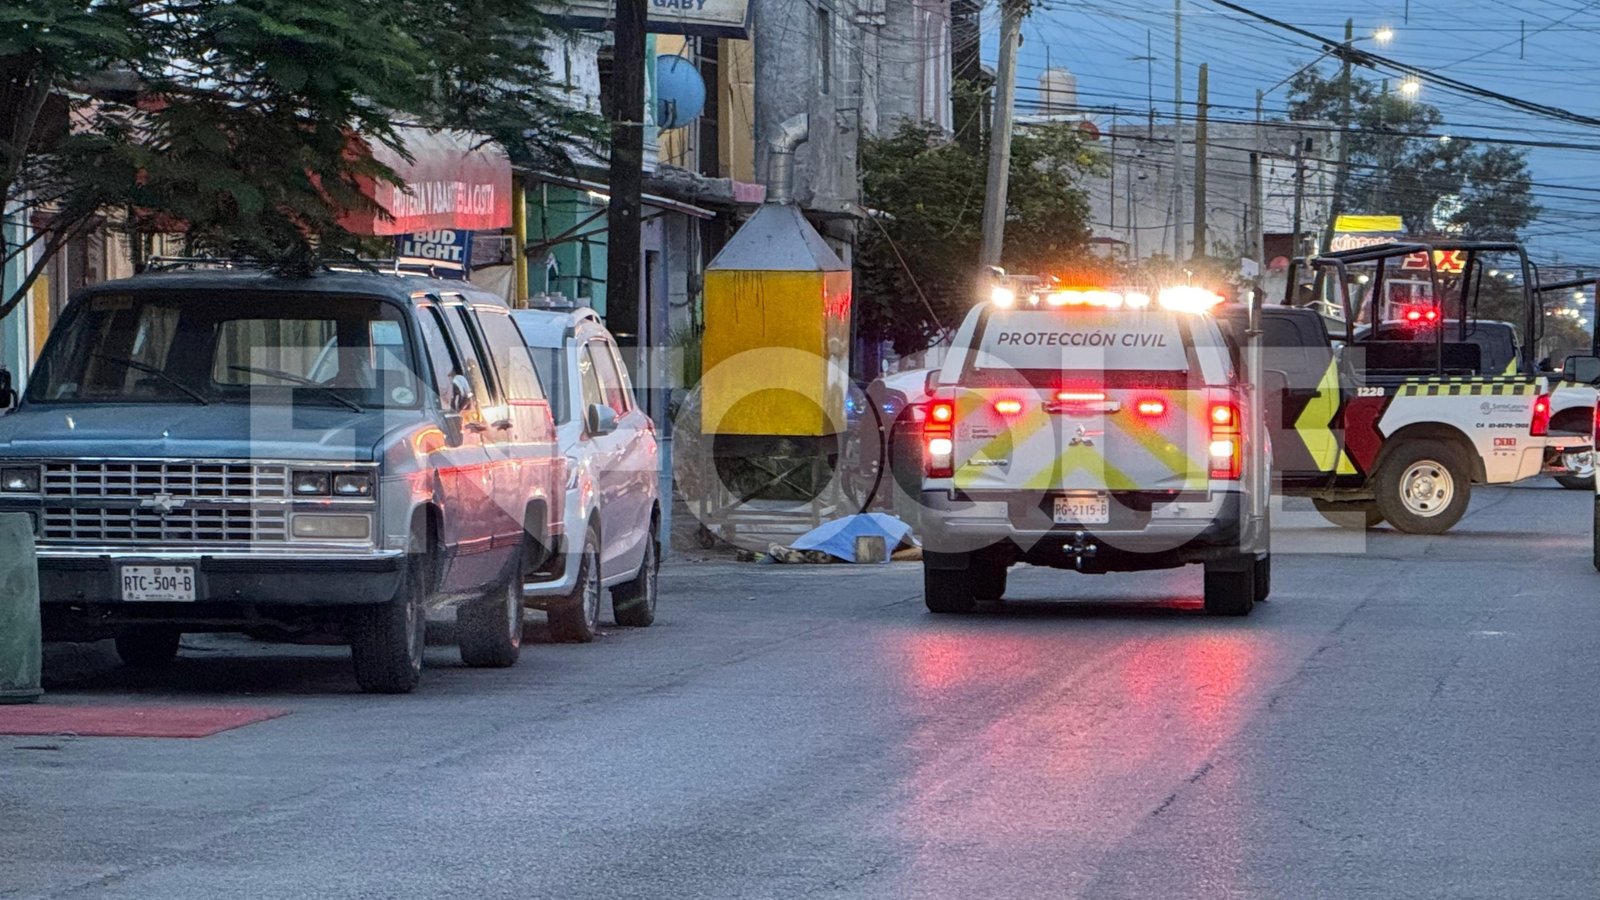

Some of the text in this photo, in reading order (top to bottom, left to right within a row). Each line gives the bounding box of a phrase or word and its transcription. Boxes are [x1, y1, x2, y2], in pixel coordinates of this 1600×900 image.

[653, 0, 705, 10] GABY
[413, 229, 456, 245] BUD
[997, 330, 1167, 348] PROTECCIÓN CIVIL
[1357, 387, 1385, 397] 1228
[1055, 503, 1107, 516] RG-2115-B
[124, 575, 192, 592] RTC-504-B
